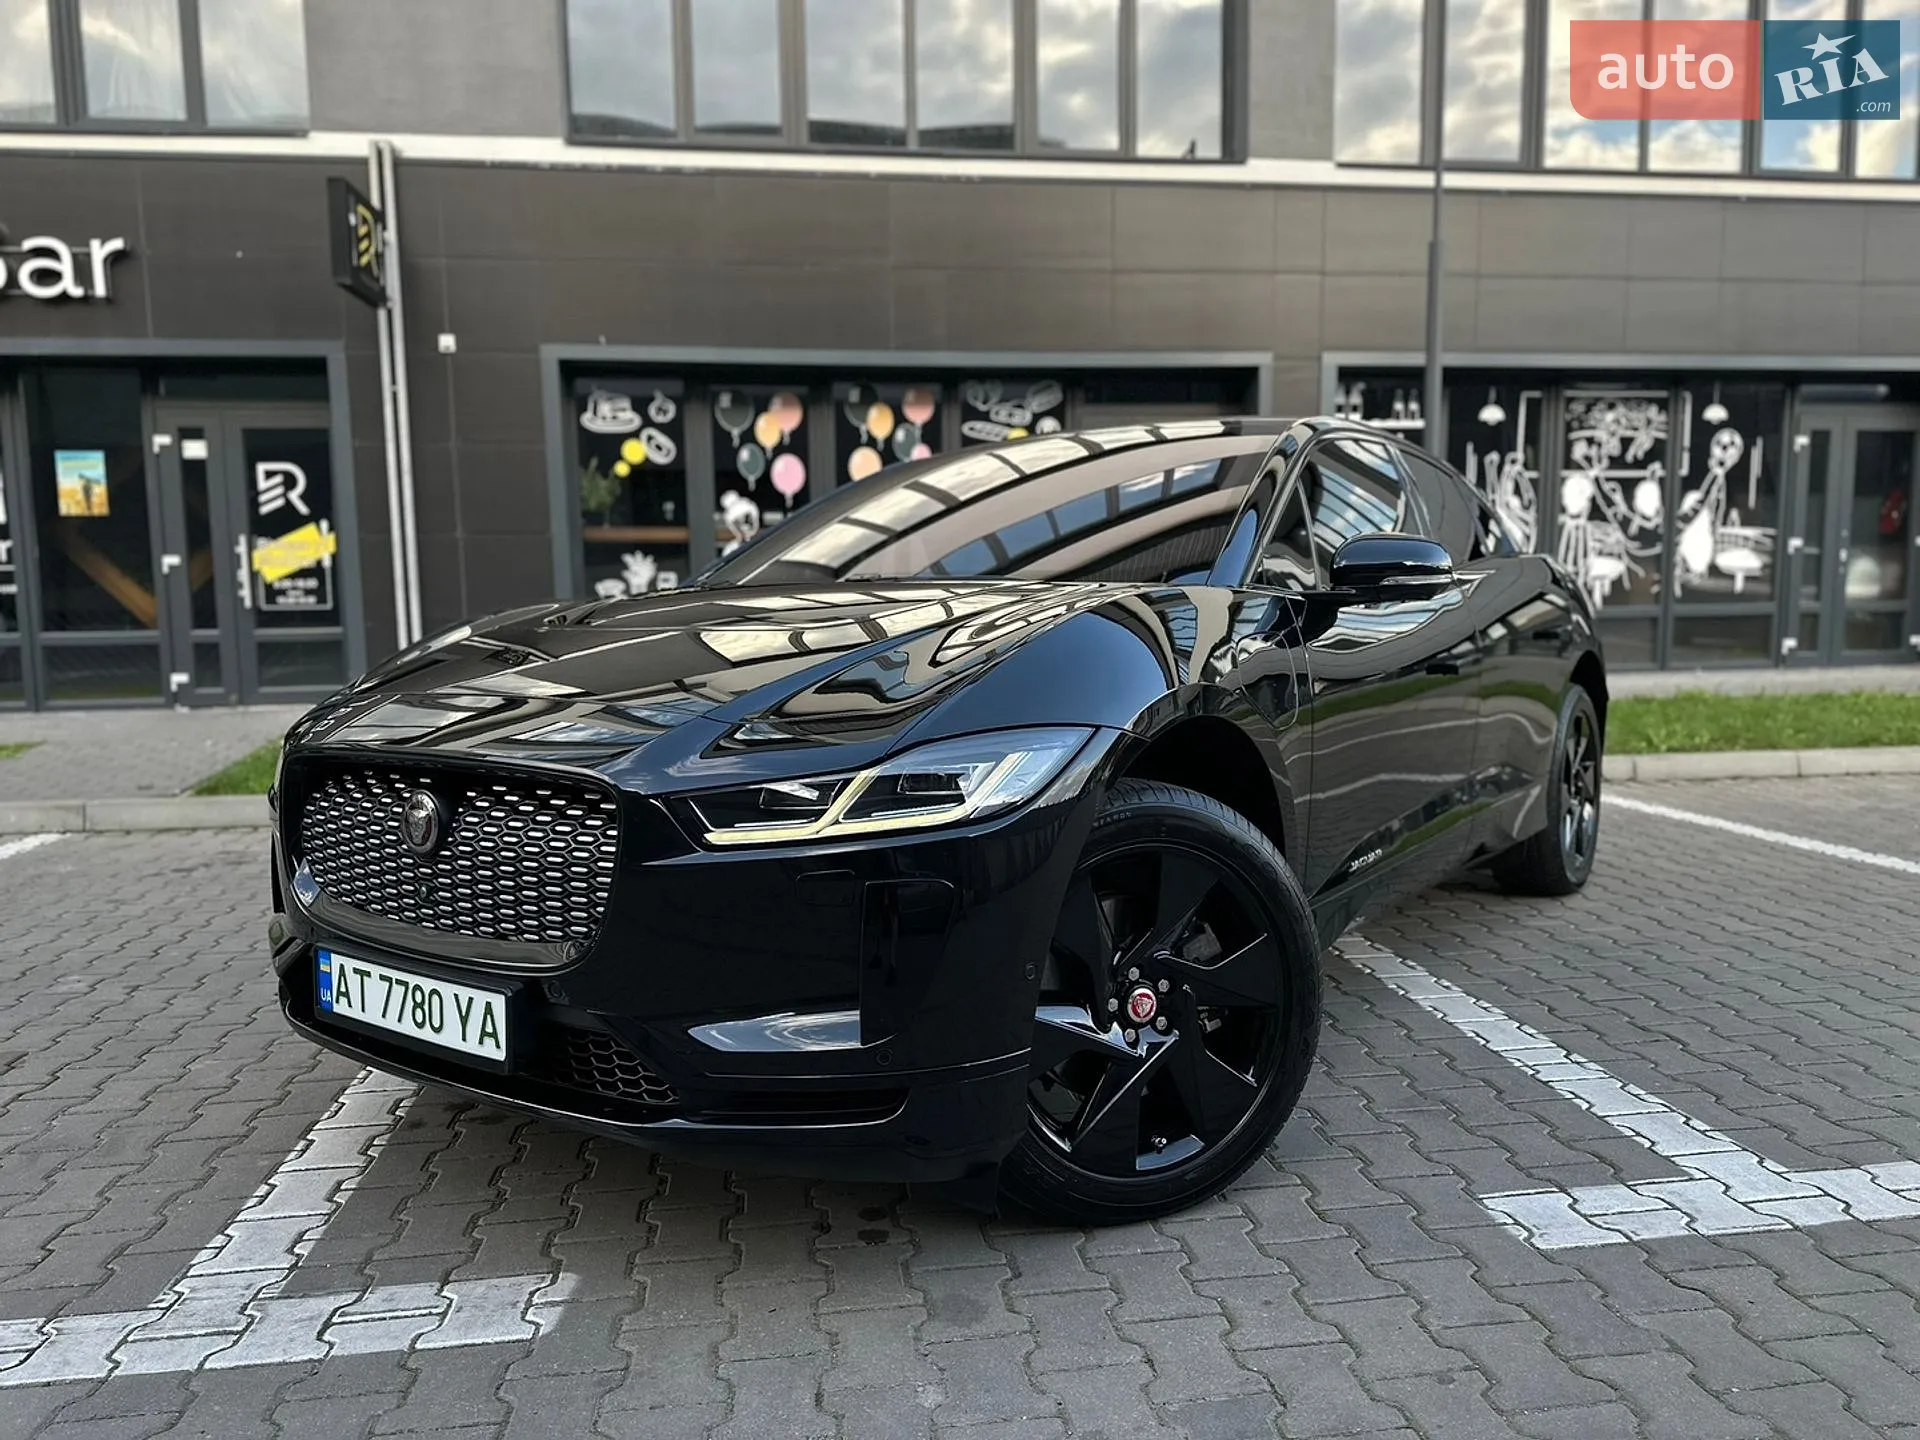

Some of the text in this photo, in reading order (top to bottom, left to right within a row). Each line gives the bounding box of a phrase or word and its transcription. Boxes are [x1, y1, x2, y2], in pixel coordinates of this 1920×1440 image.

[0, 236, 125, 299] ar
[320, 988, 332, 1003] UA
[335, 963, 501, 1049] AT 7780 YA
